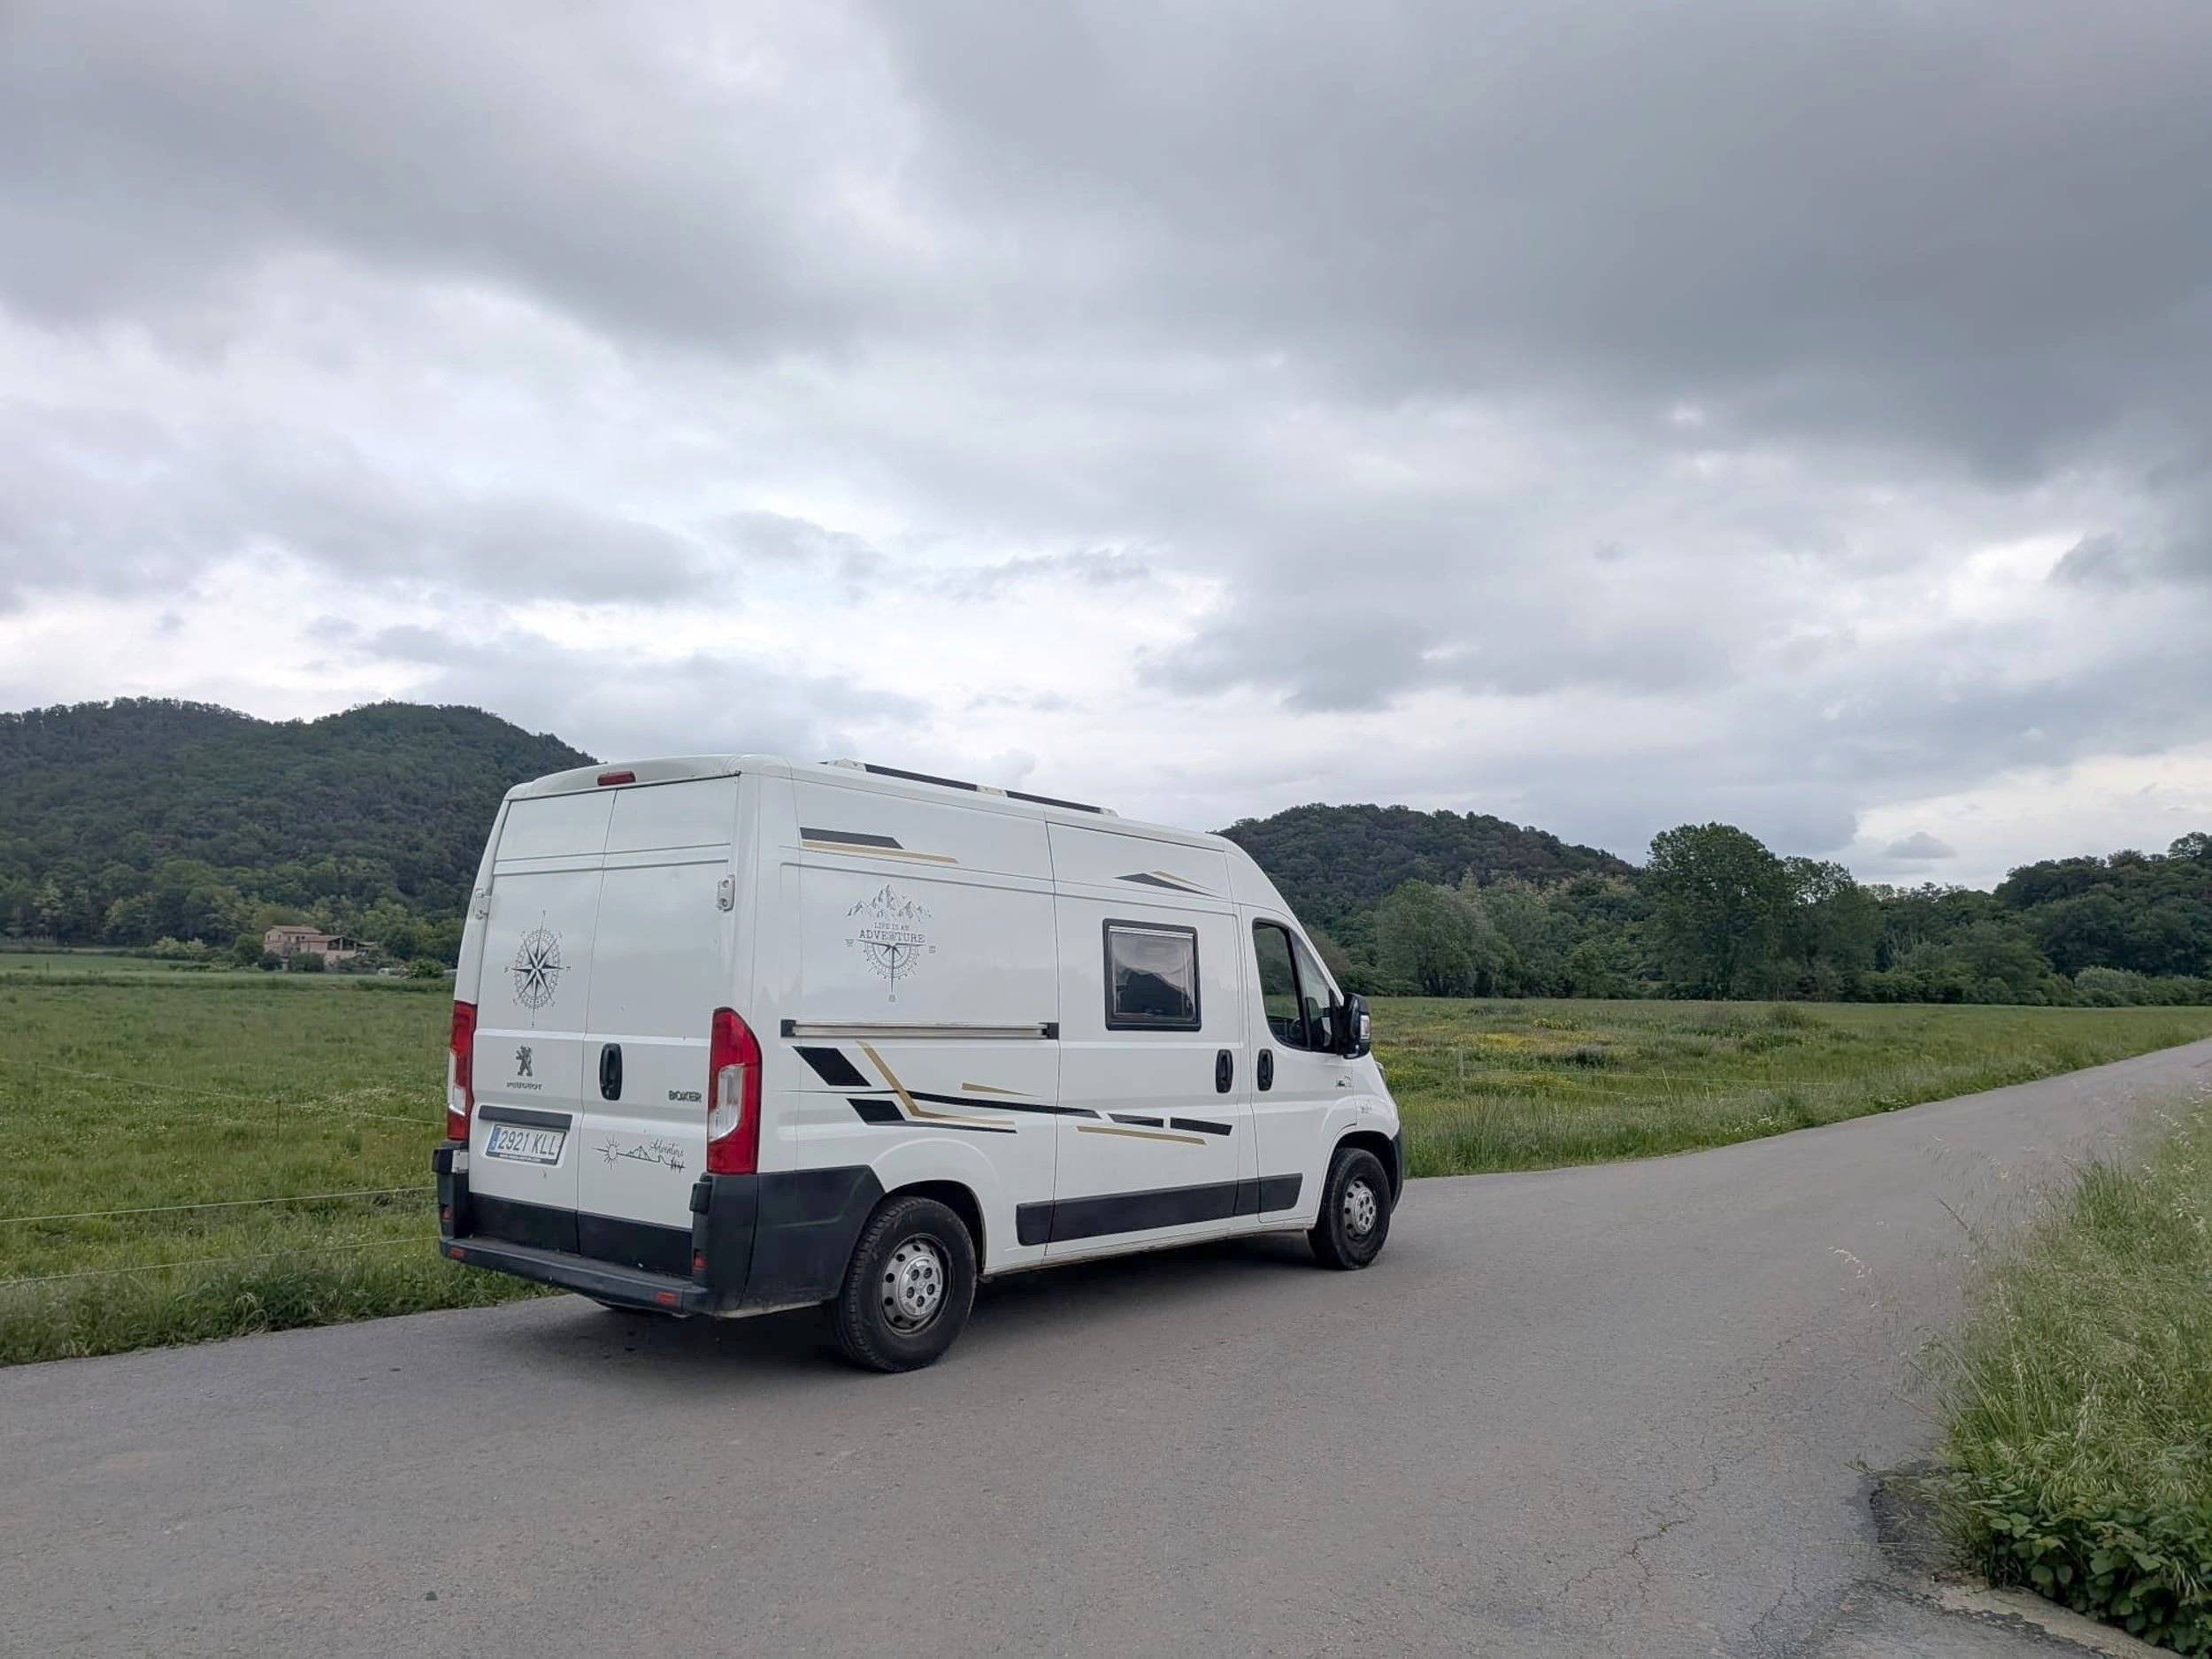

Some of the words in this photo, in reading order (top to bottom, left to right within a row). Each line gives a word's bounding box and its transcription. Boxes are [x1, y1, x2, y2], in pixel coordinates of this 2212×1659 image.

[506, 1081, 542, 1090] PEUGEOT
[669, 1090, 702, 1102] BOXER
[498, 1130, 531, 1152] 2921
[531, 1133, 557, 1156] KLL
